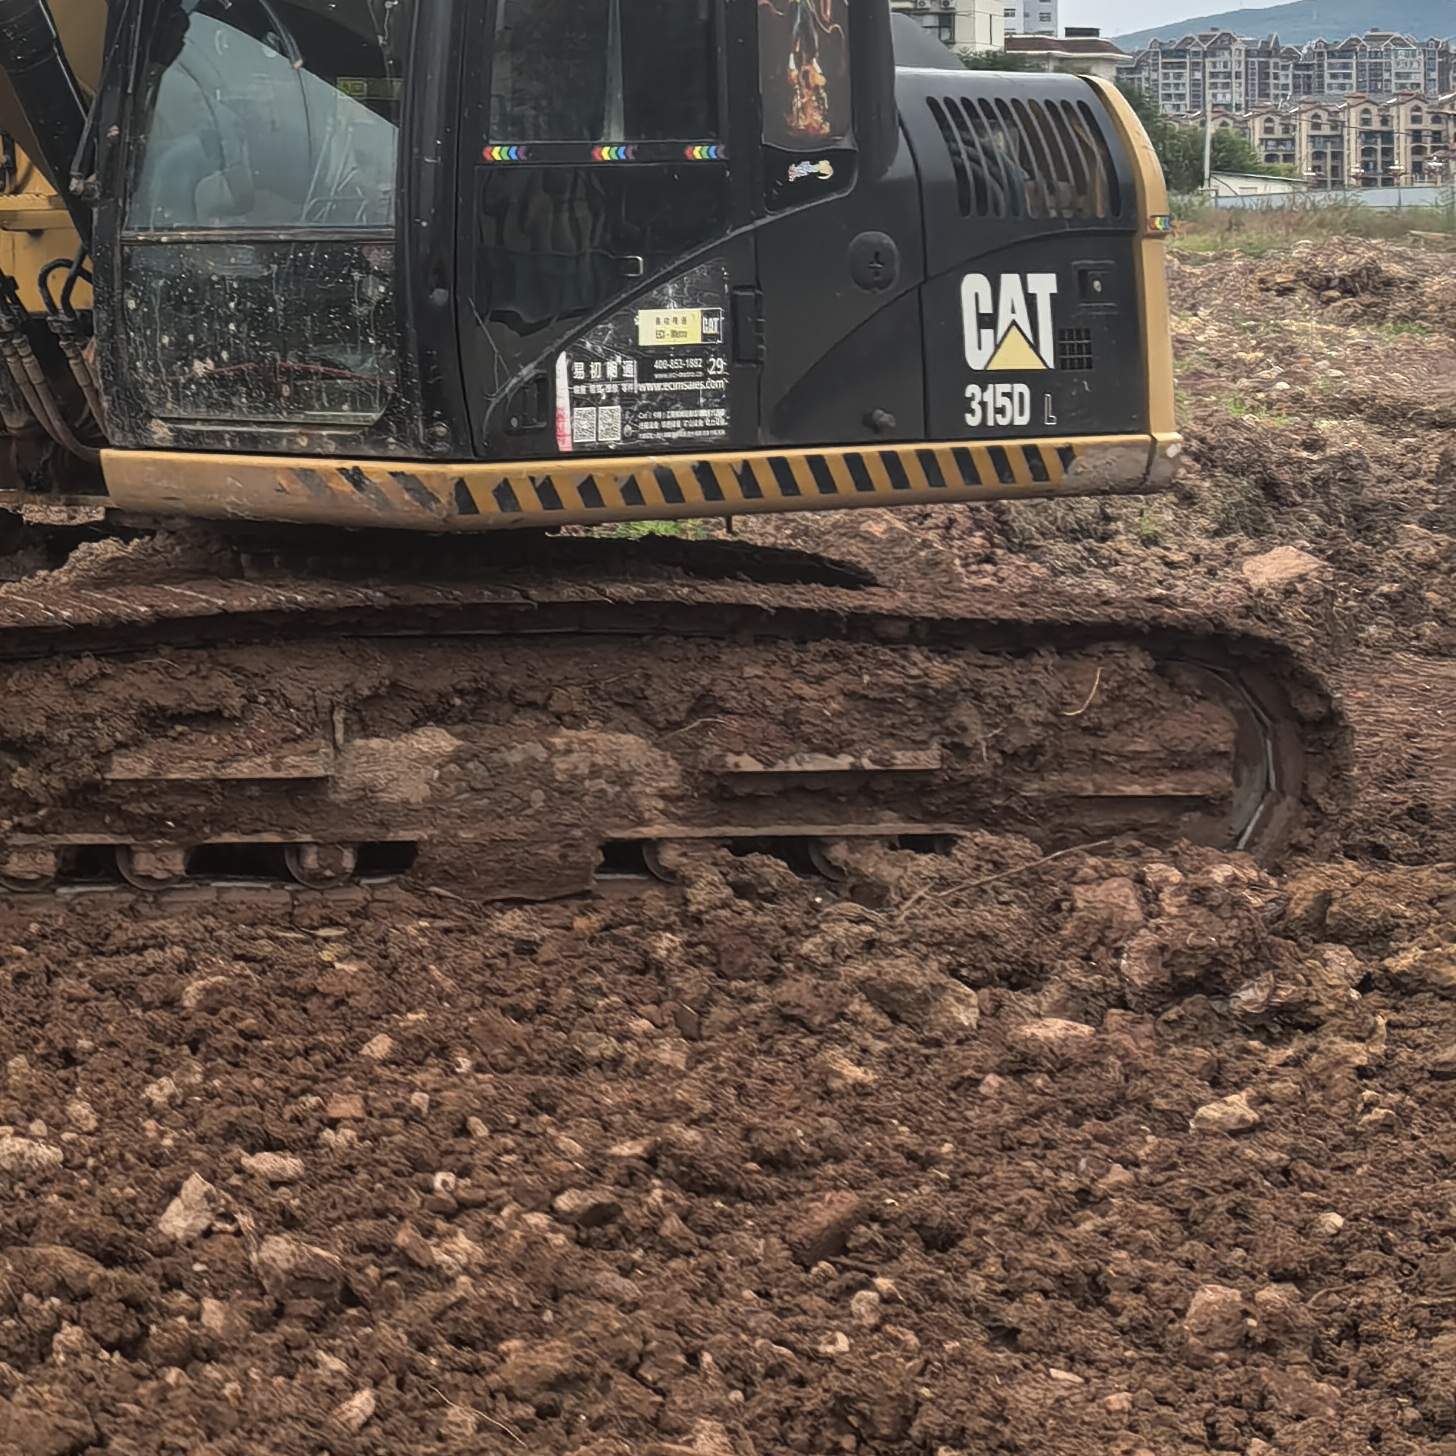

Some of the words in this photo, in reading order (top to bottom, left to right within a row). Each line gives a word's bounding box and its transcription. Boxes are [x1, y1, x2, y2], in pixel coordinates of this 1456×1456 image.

[961, 273, 1058, 370] CAT
[964, 383, 1030, 427] 315D
[1044, 393, 1057, 425] L
